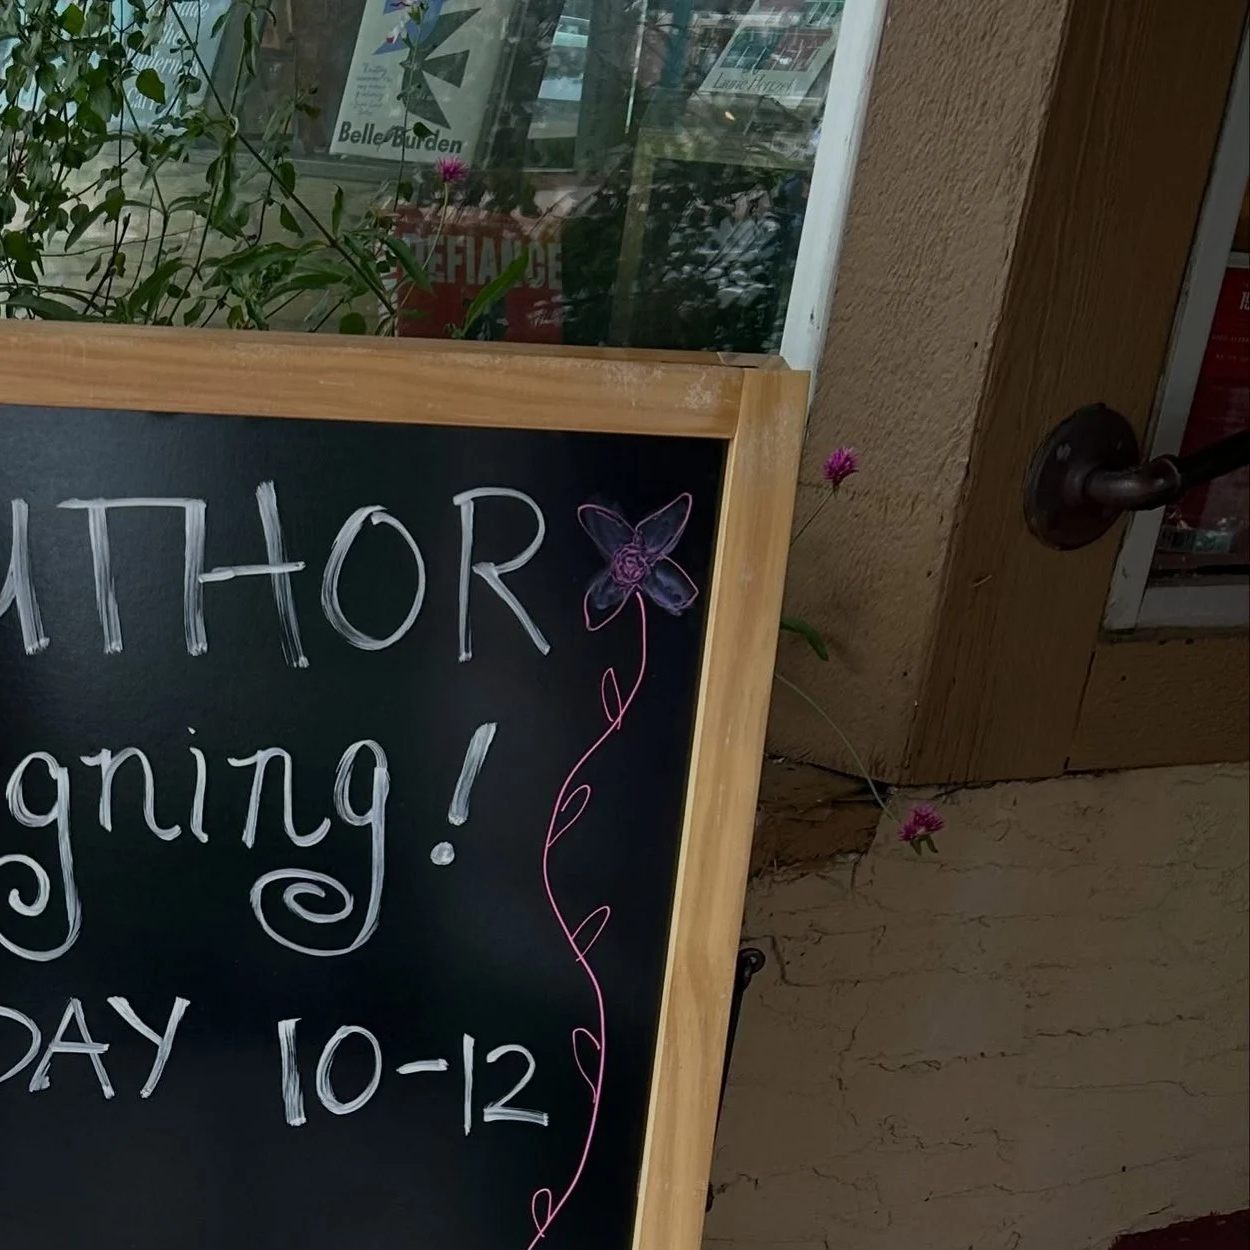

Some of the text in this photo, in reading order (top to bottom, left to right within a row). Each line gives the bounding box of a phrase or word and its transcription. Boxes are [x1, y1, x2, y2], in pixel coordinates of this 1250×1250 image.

[338, 121, 463, 154] Belle Burden
[277, 1018, 549, 1136] 10-12
